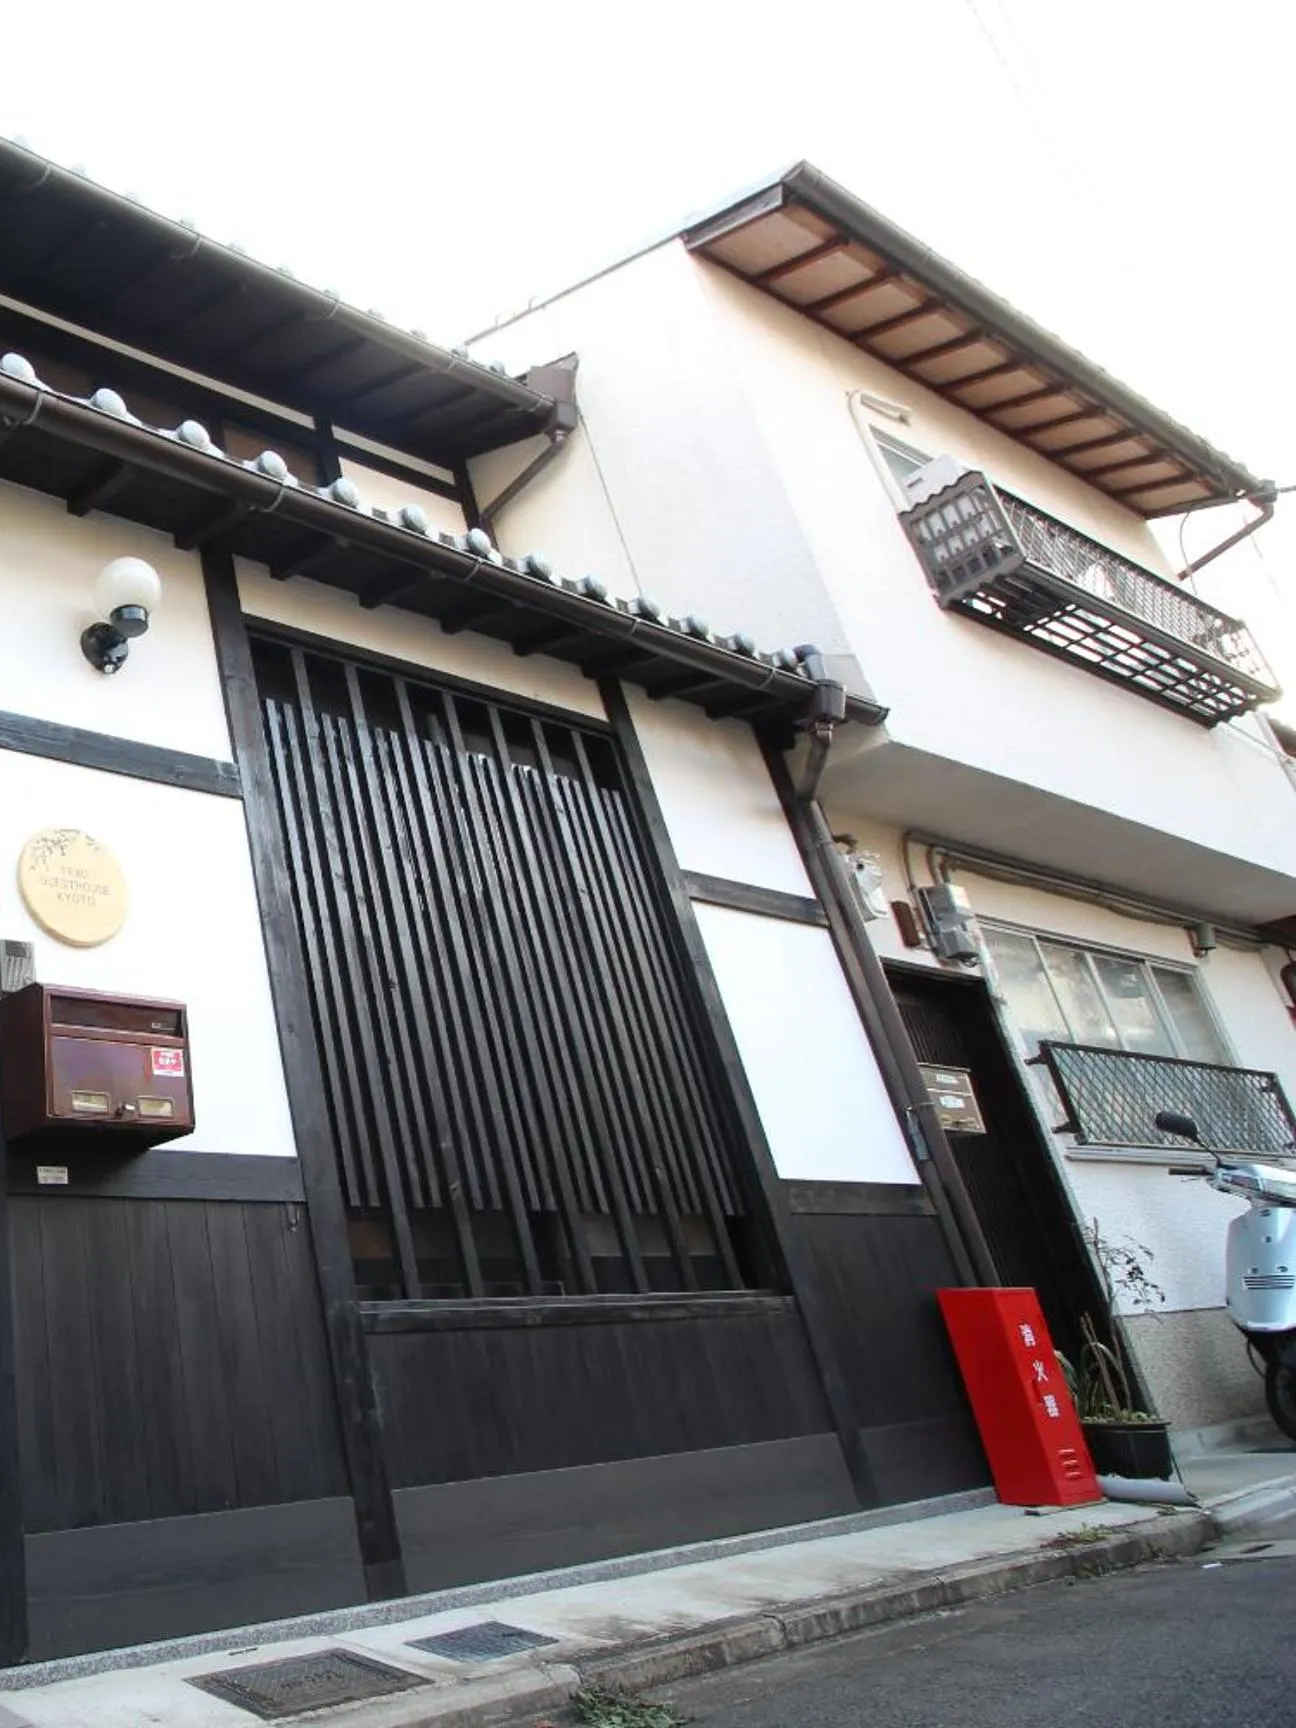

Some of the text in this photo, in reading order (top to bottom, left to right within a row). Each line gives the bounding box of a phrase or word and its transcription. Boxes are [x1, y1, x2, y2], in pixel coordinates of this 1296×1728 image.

[39, 874, 111, 896] GUESTHOUSE
[57, 891, 96, 907] KYOTO
[1019, 1323, 1060, 1418] 消火器
